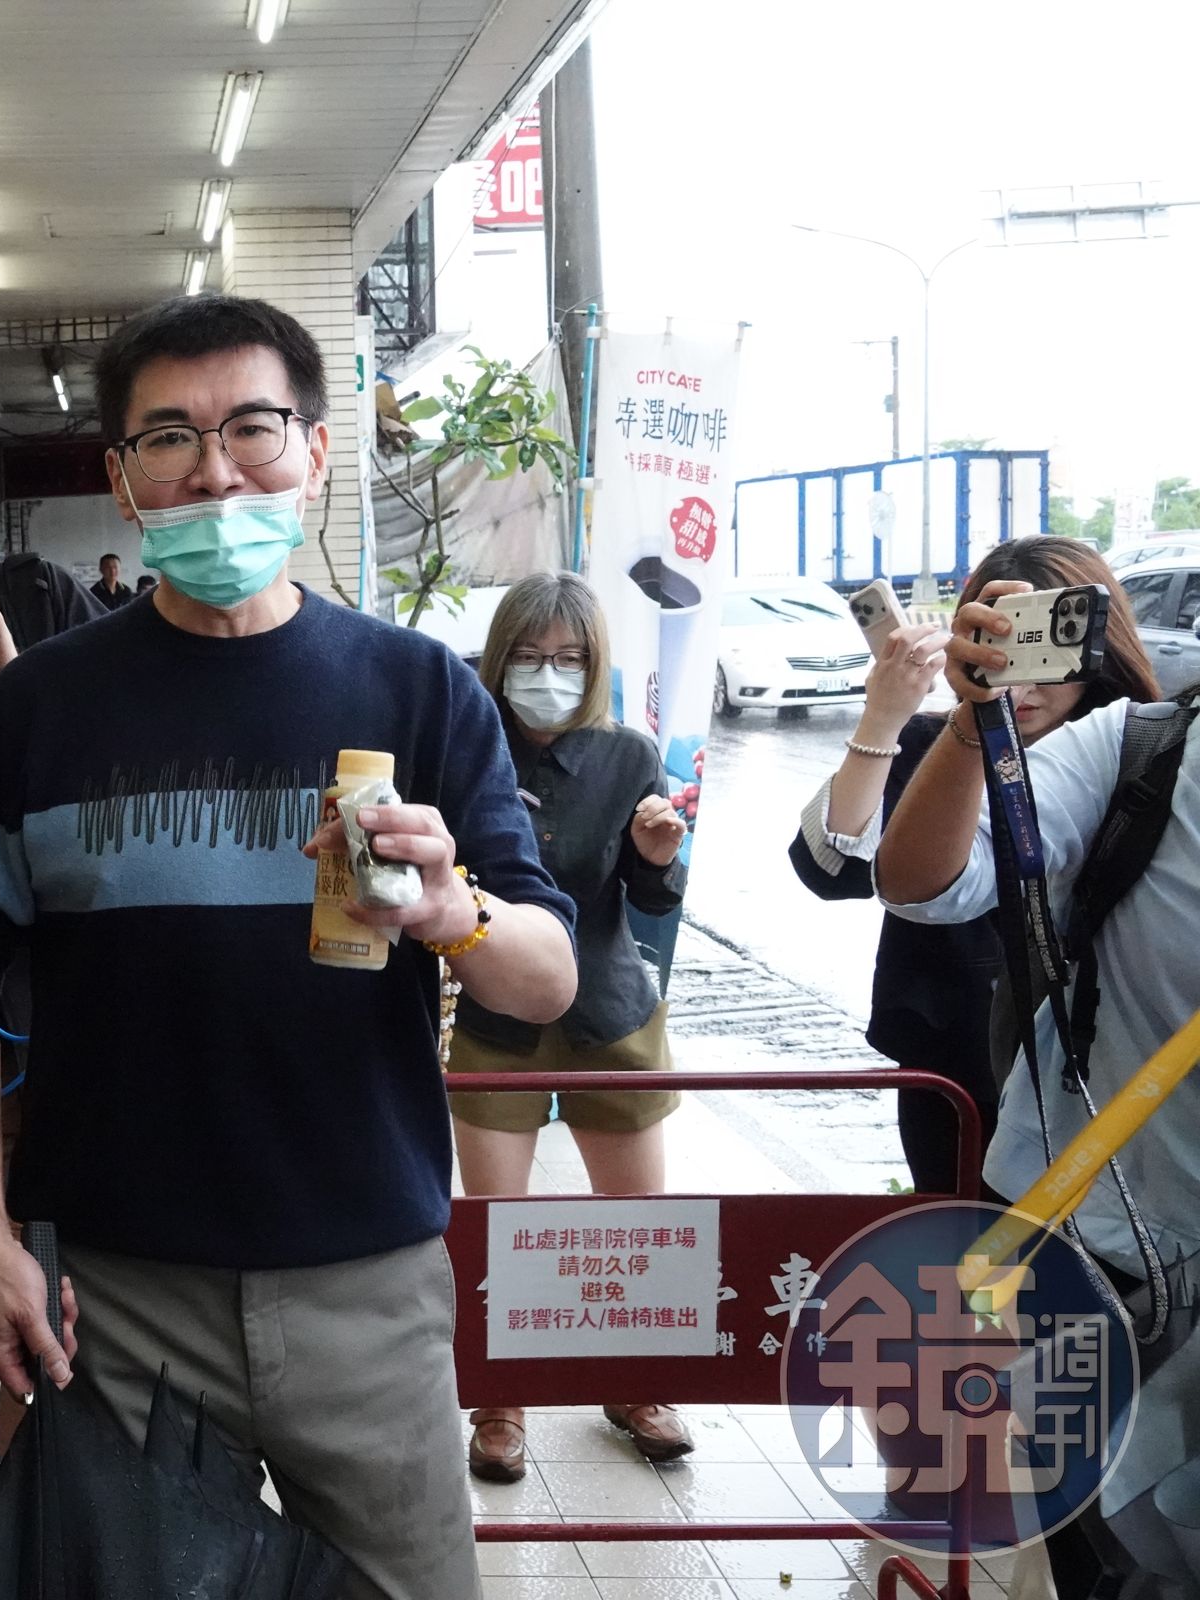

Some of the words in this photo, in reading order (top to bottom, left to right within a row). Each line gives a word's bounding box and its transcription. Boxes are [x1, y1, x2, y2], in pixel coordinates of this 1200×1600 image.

[637, 370, 665, 385] CITY
[513, 1227, 697, 1250] 此處非醫院停車場
[558, 1254, 650, 1277] 請勿久停
[581, 1281, 626, 1302] 避免
[507, 1307, 699, 1330] 影響行人/輪椅進出
